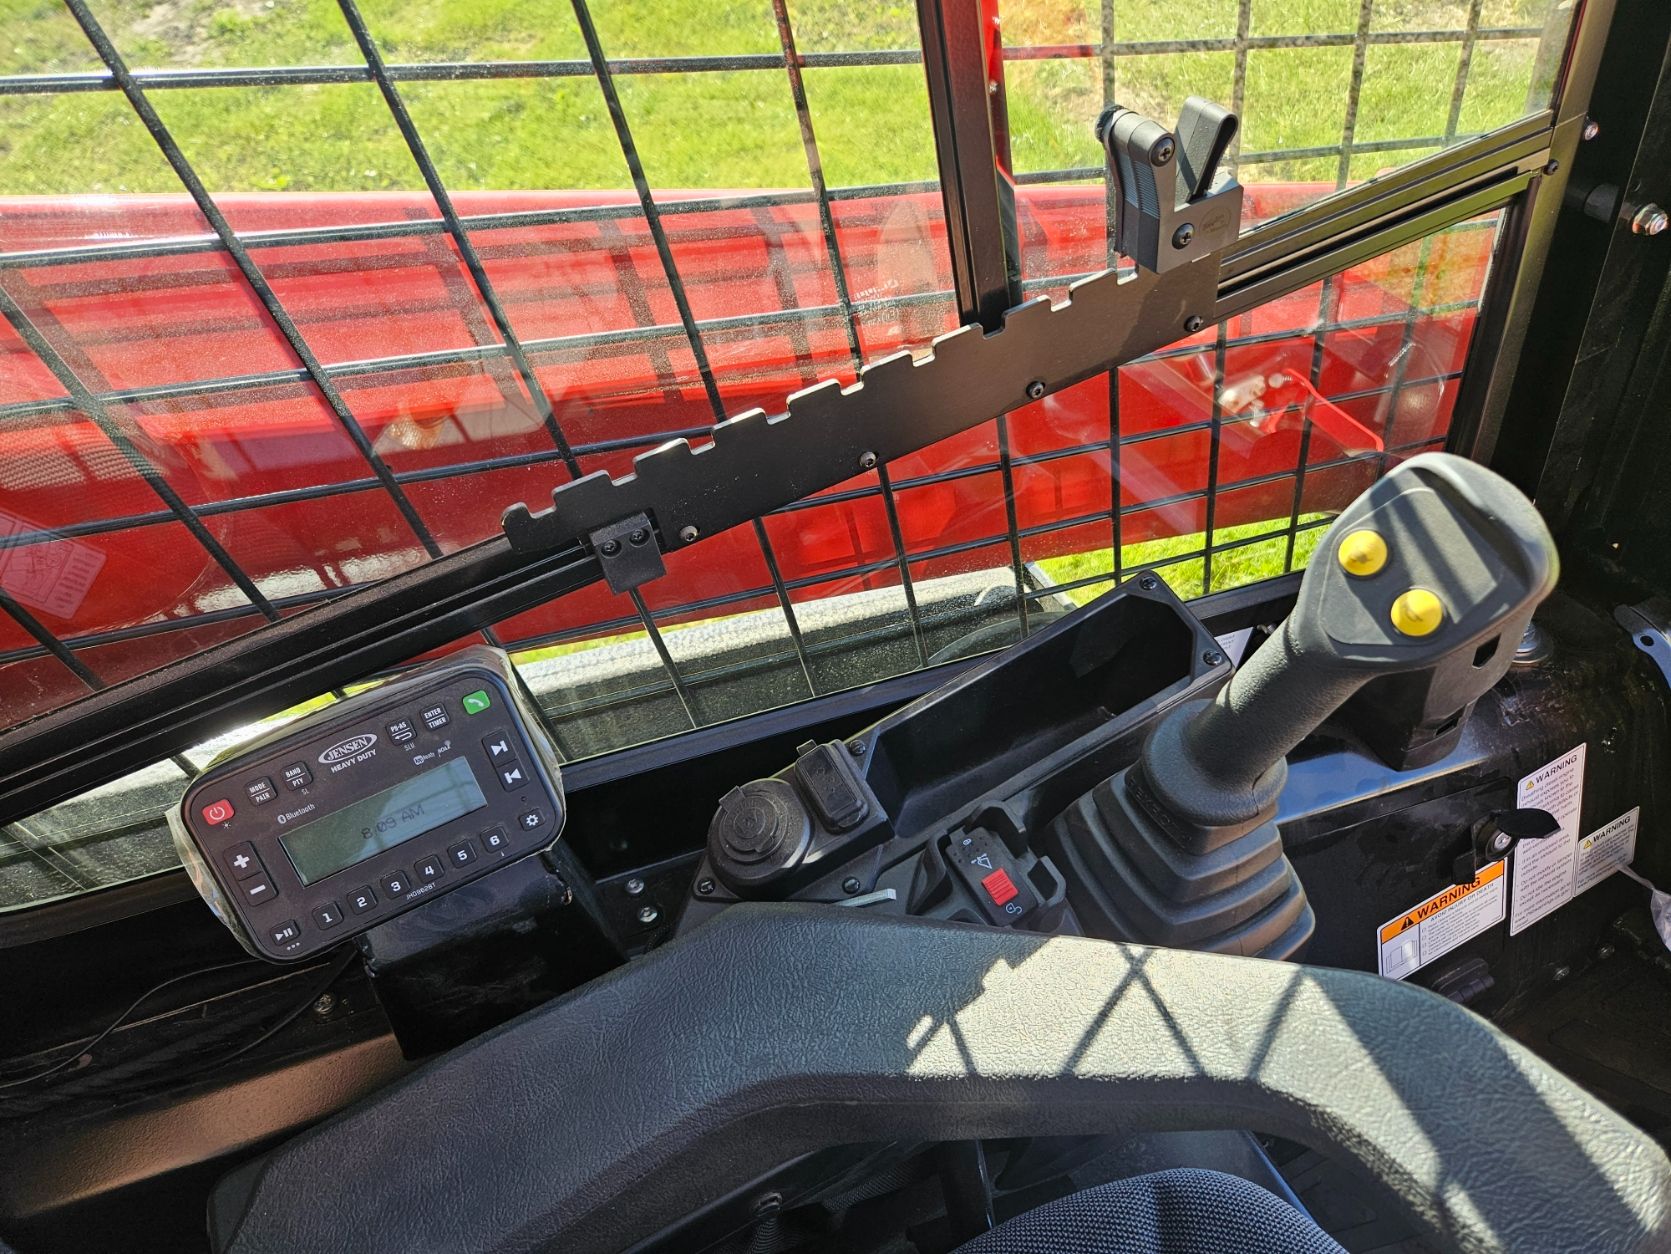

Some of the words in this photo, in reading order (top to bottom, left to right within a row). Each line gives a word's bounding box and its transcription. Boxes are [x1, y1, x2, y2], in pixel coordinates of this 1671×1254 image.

[424, 707, 442, 719] ENTER
[428, 717, 447, 729] TIMER
[327, 735, 368, 761] JENSEN
[331, 756, 357, 774] HEAVY
[356, 748, 377, 764] DUTY
[285, 766, 302, 778] BAND
[1536, 754, 1577, 784] WARNING
[249, 781, 267, 793] MODE
[292, 777, 304, 787] PTY
[255, 792, 271, 803] PAIR
[285, 803, 316, 820] Bluetooth
[401, 804, 425, 823] AM
[1593, 816, 1630, 842] WARNING
[489, 835, 500, 846] 6
[457, 850, 468, 861] 5
[425, 866, 434, 877] 4
[390, 881, 401, 892] 3
[356, 896, 368, 908] 2
[1417, 877, 1481, 919] WARNING
[322, 912, 333, 923] 1
